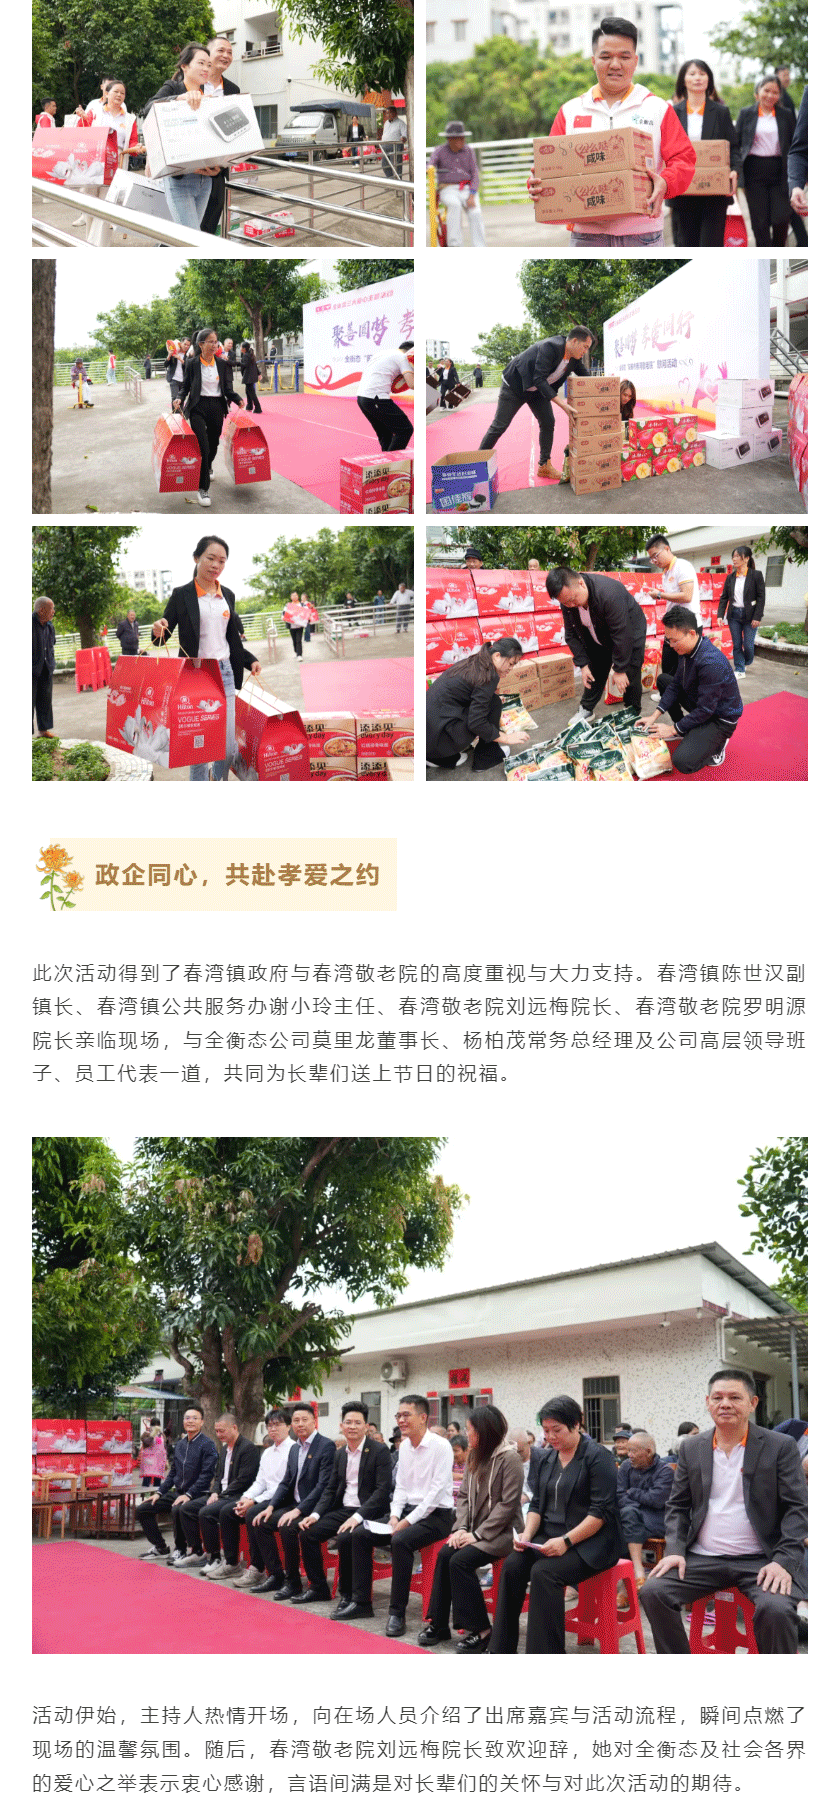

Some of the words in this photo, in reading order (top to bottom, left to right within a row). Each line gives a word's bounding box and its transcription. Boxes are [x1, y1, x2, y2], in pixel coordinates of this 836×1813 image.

[587, 151, 606, 164] 咸味
[587, 194, 606, 207] 咸味
[177, 715, 199, 723] VOGUE
[96, 863, 380, 887] 政企同心，共赴孝爱之约
[33, 1064, 507, 1083] 子、员工代表一道，共同为长辈们送上节日的祝福。
[33, 1706, 804, 1725] 活动伊始，主持人热情开场，向在场人员介绍了出席嘉宾与活动流程，瞬间点燃了
[33, 1739, 805, 1759] 现场的温馨氛围。随后，春湾敬老院刘远梅院长致欢迎辞，她对全衡态及社会各界
[33, 1774, 741, 1793] 的爱心之举表示衷心感谢，言语间满是对长辈们的关怀与对此次活动的期待。
